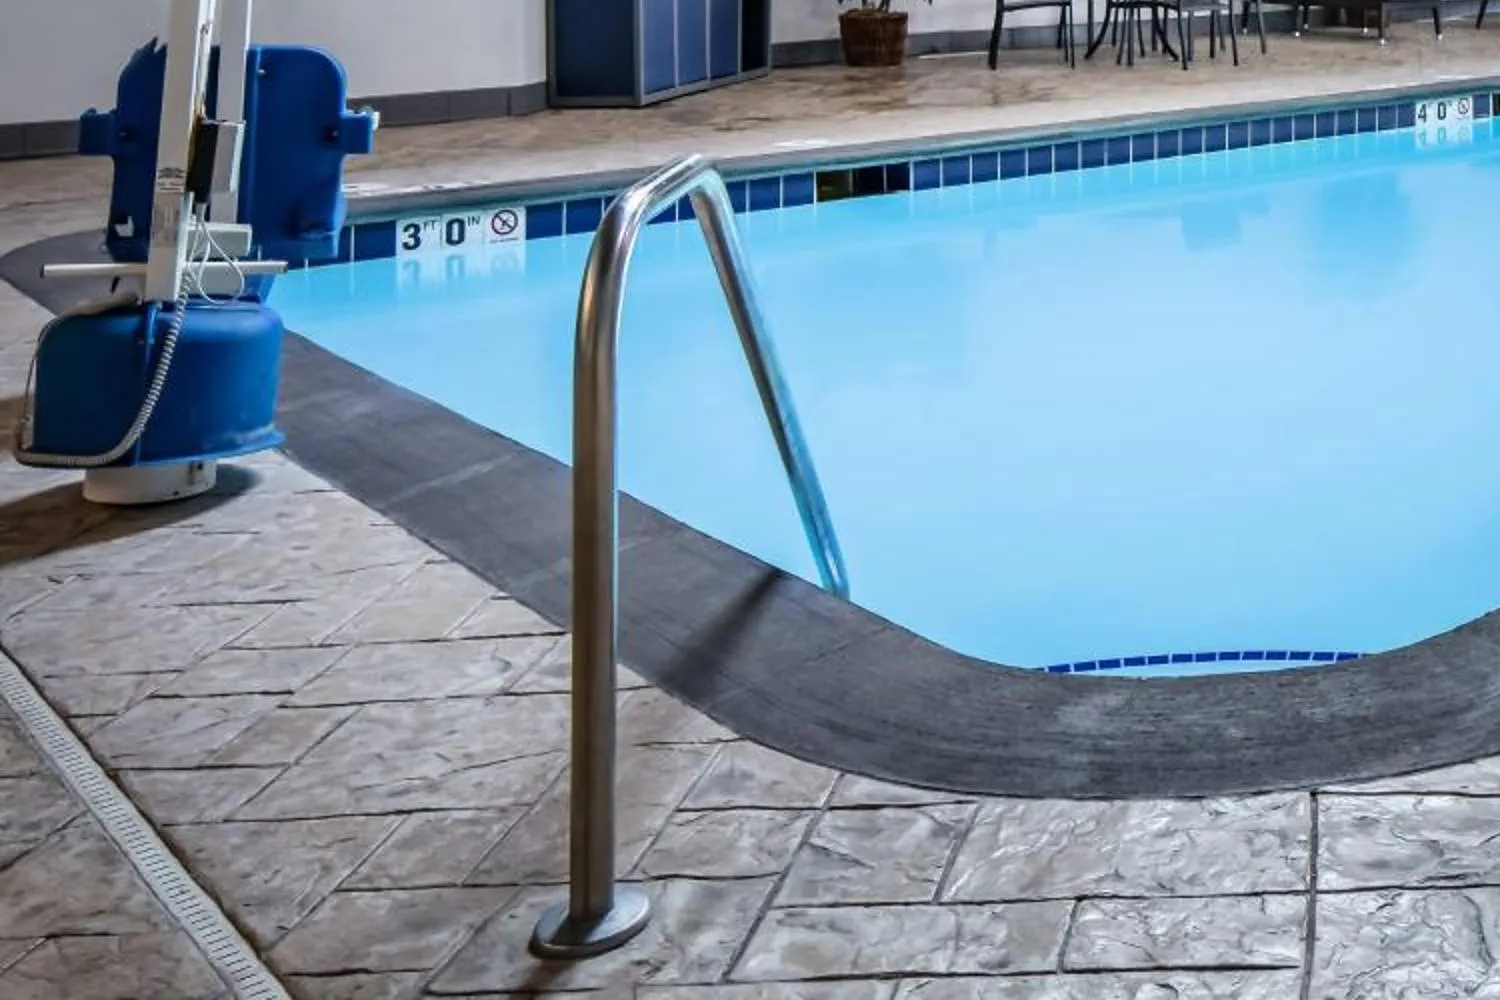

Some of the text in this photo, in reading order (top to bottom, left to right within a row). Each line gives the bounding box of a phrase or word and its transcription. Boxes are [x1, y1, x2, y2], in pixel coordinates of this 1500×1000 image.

[1417, 103, 1427, 123] 4
[1437, 101, 1447, 121] 0
[402, 215, 481, 251] 3 FT 0 IN
